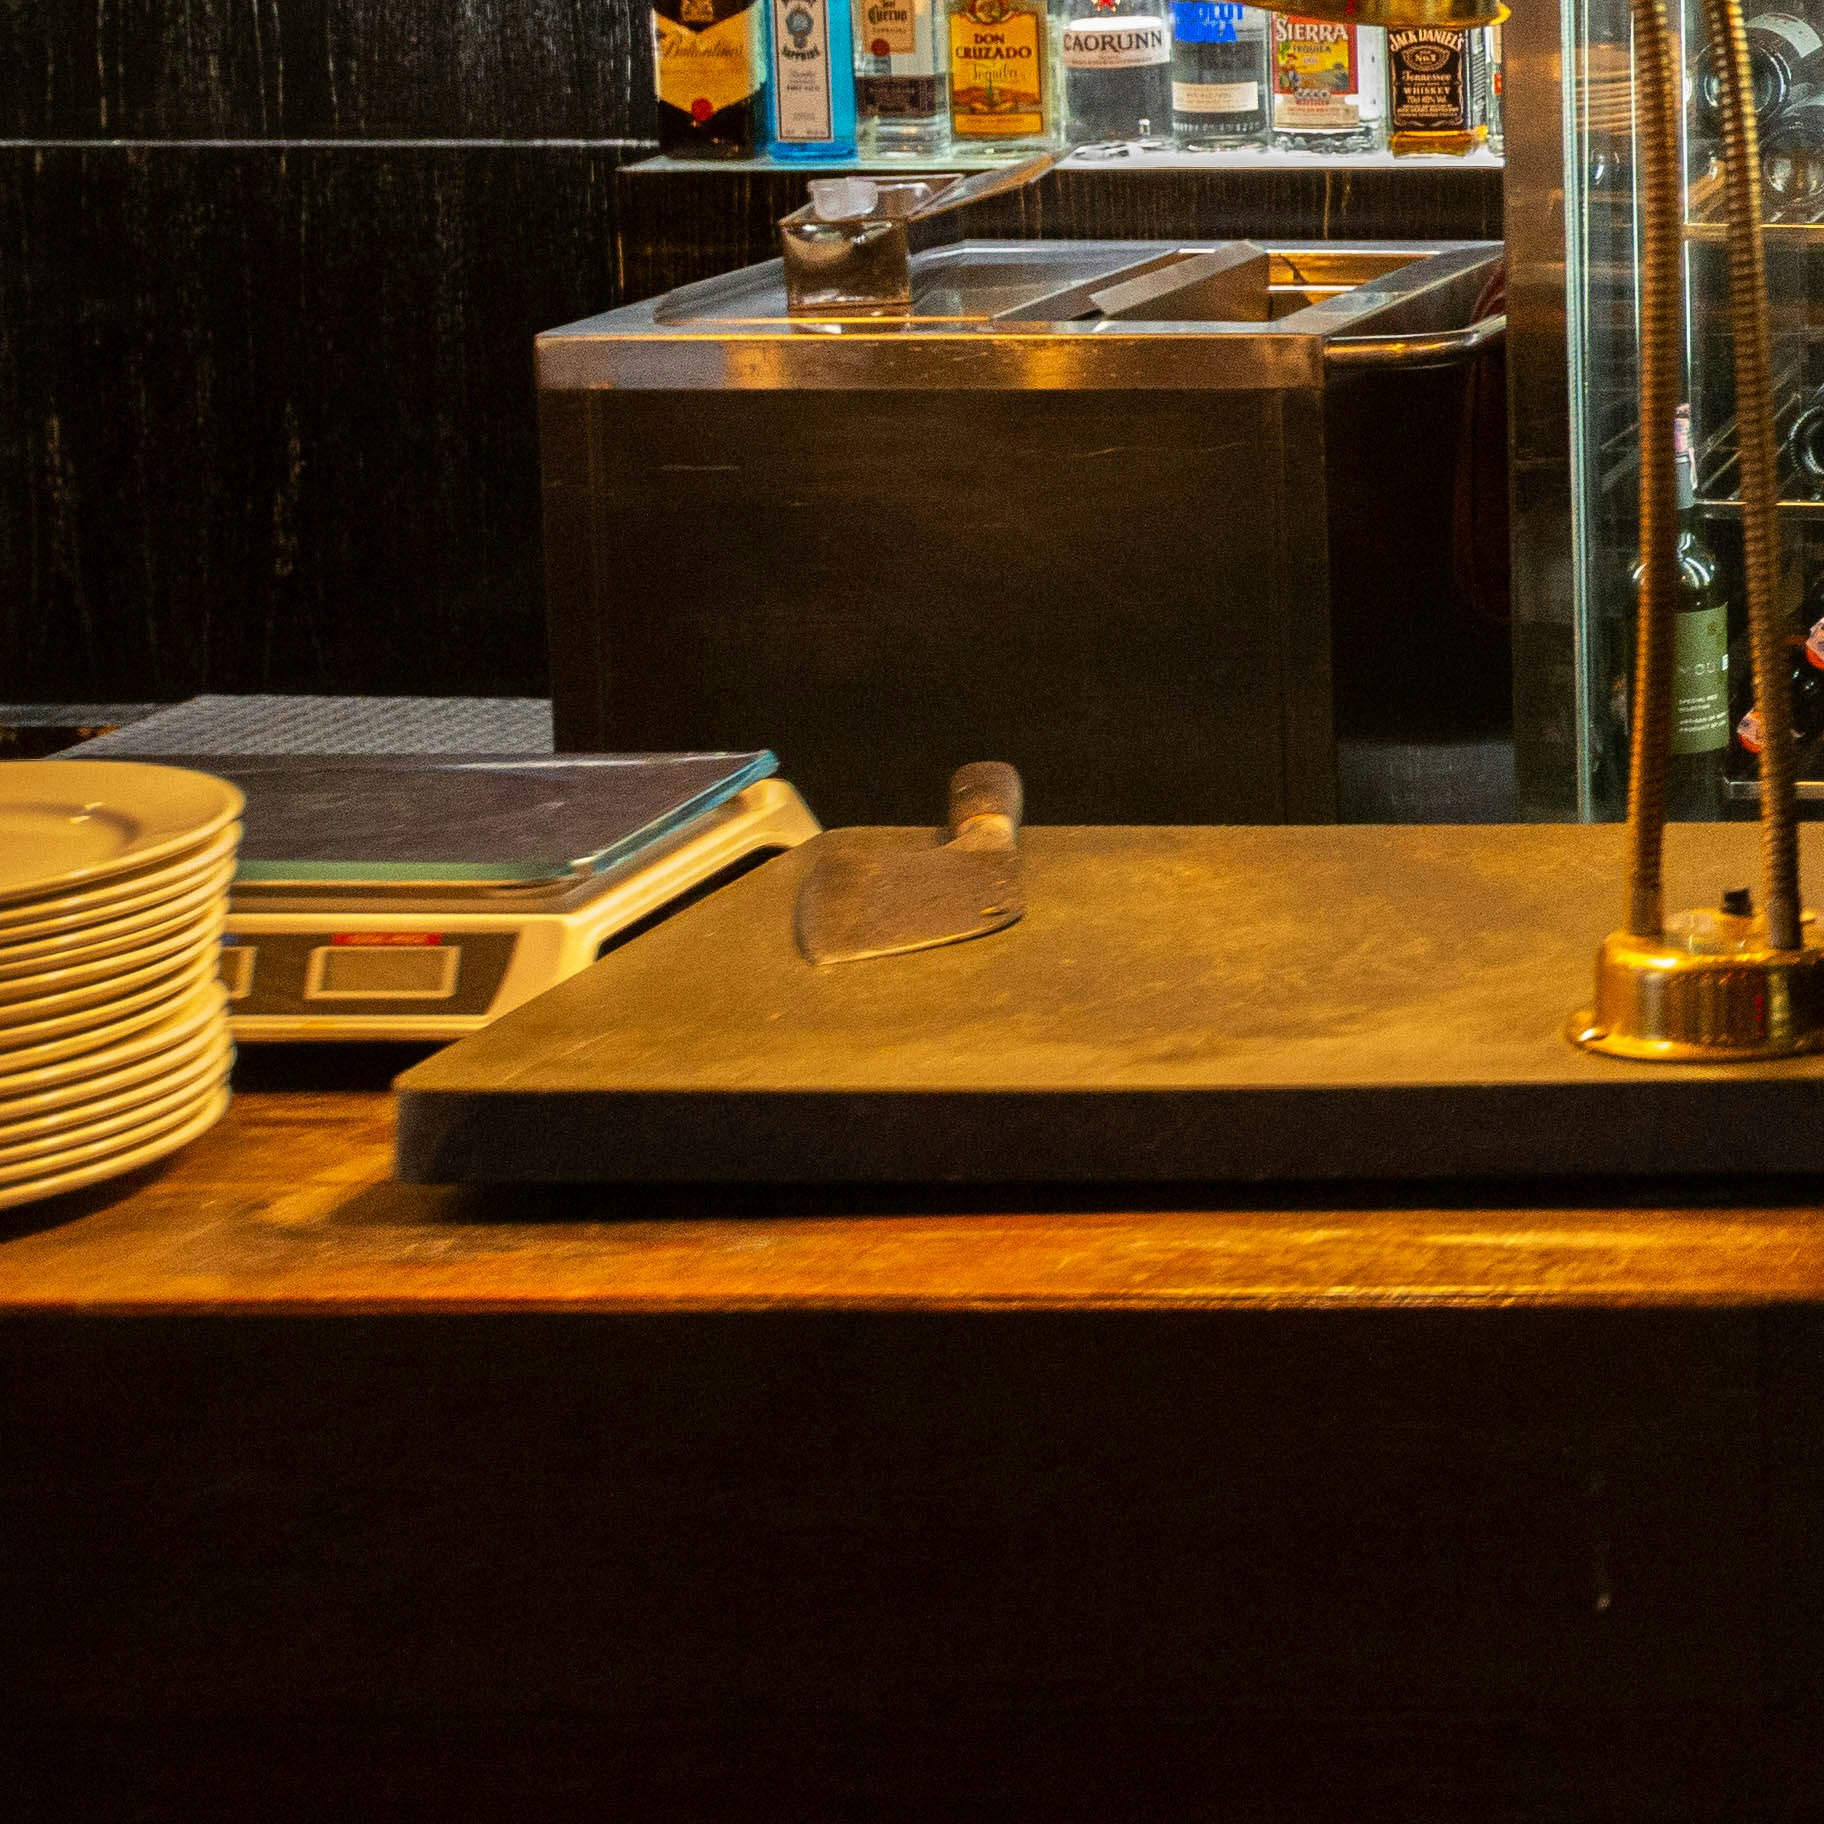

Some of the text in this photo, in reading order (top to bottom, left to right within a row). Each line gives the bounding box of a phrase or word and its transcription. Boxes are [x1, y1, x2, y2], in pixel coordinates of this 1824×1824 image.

[974, 33, 1005, 44] DON
[1276, 16, 1349, 43] SIERRA
[1063, 30, 1163, 53] CAORUNN
[1389, 30, 1418, 52] JACK
[955, 46, 1033, 60] CRUZADO
